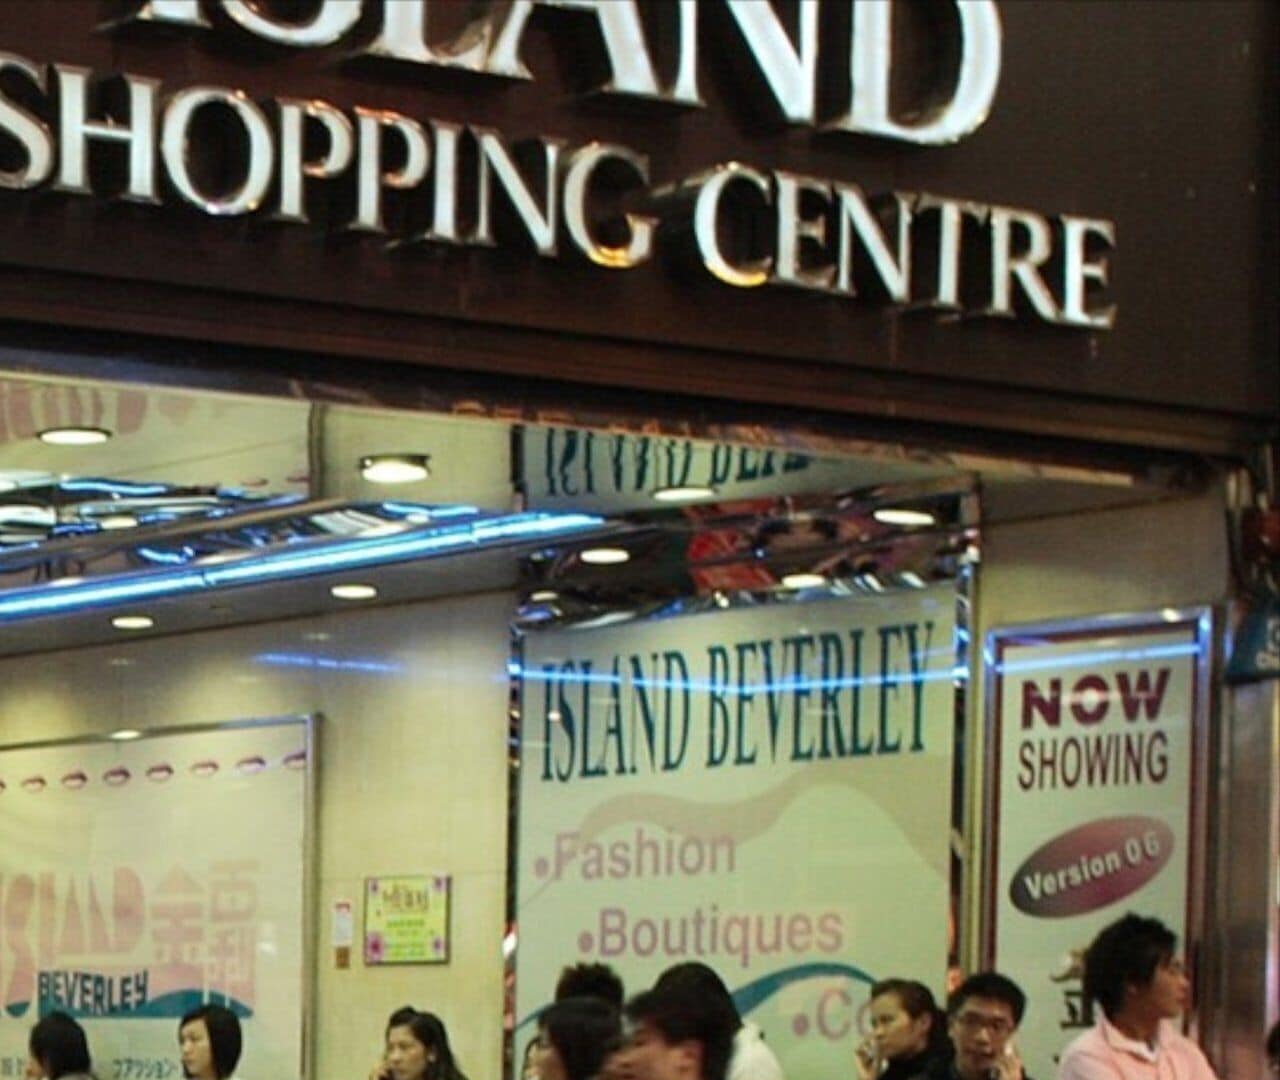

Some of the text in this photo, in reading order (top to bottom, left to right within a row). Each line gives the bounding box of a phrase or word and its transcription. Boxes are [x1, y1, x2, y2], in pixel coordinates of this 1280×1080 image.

[683, 160, 1118, 329] CENTRE
[540, 621, 935, 783] ISLAND BEVERLEY
[1021, 667, 1172, 730] NOW
[1018, 731, 1169, 790] SHOWING
[553, 827, 738, 881] Fashion
[1024, 851, 1122, 900] Version
[598, 904, 844, 967] Boutiques
[38, 967, 151, 1015] BEVERLEY
